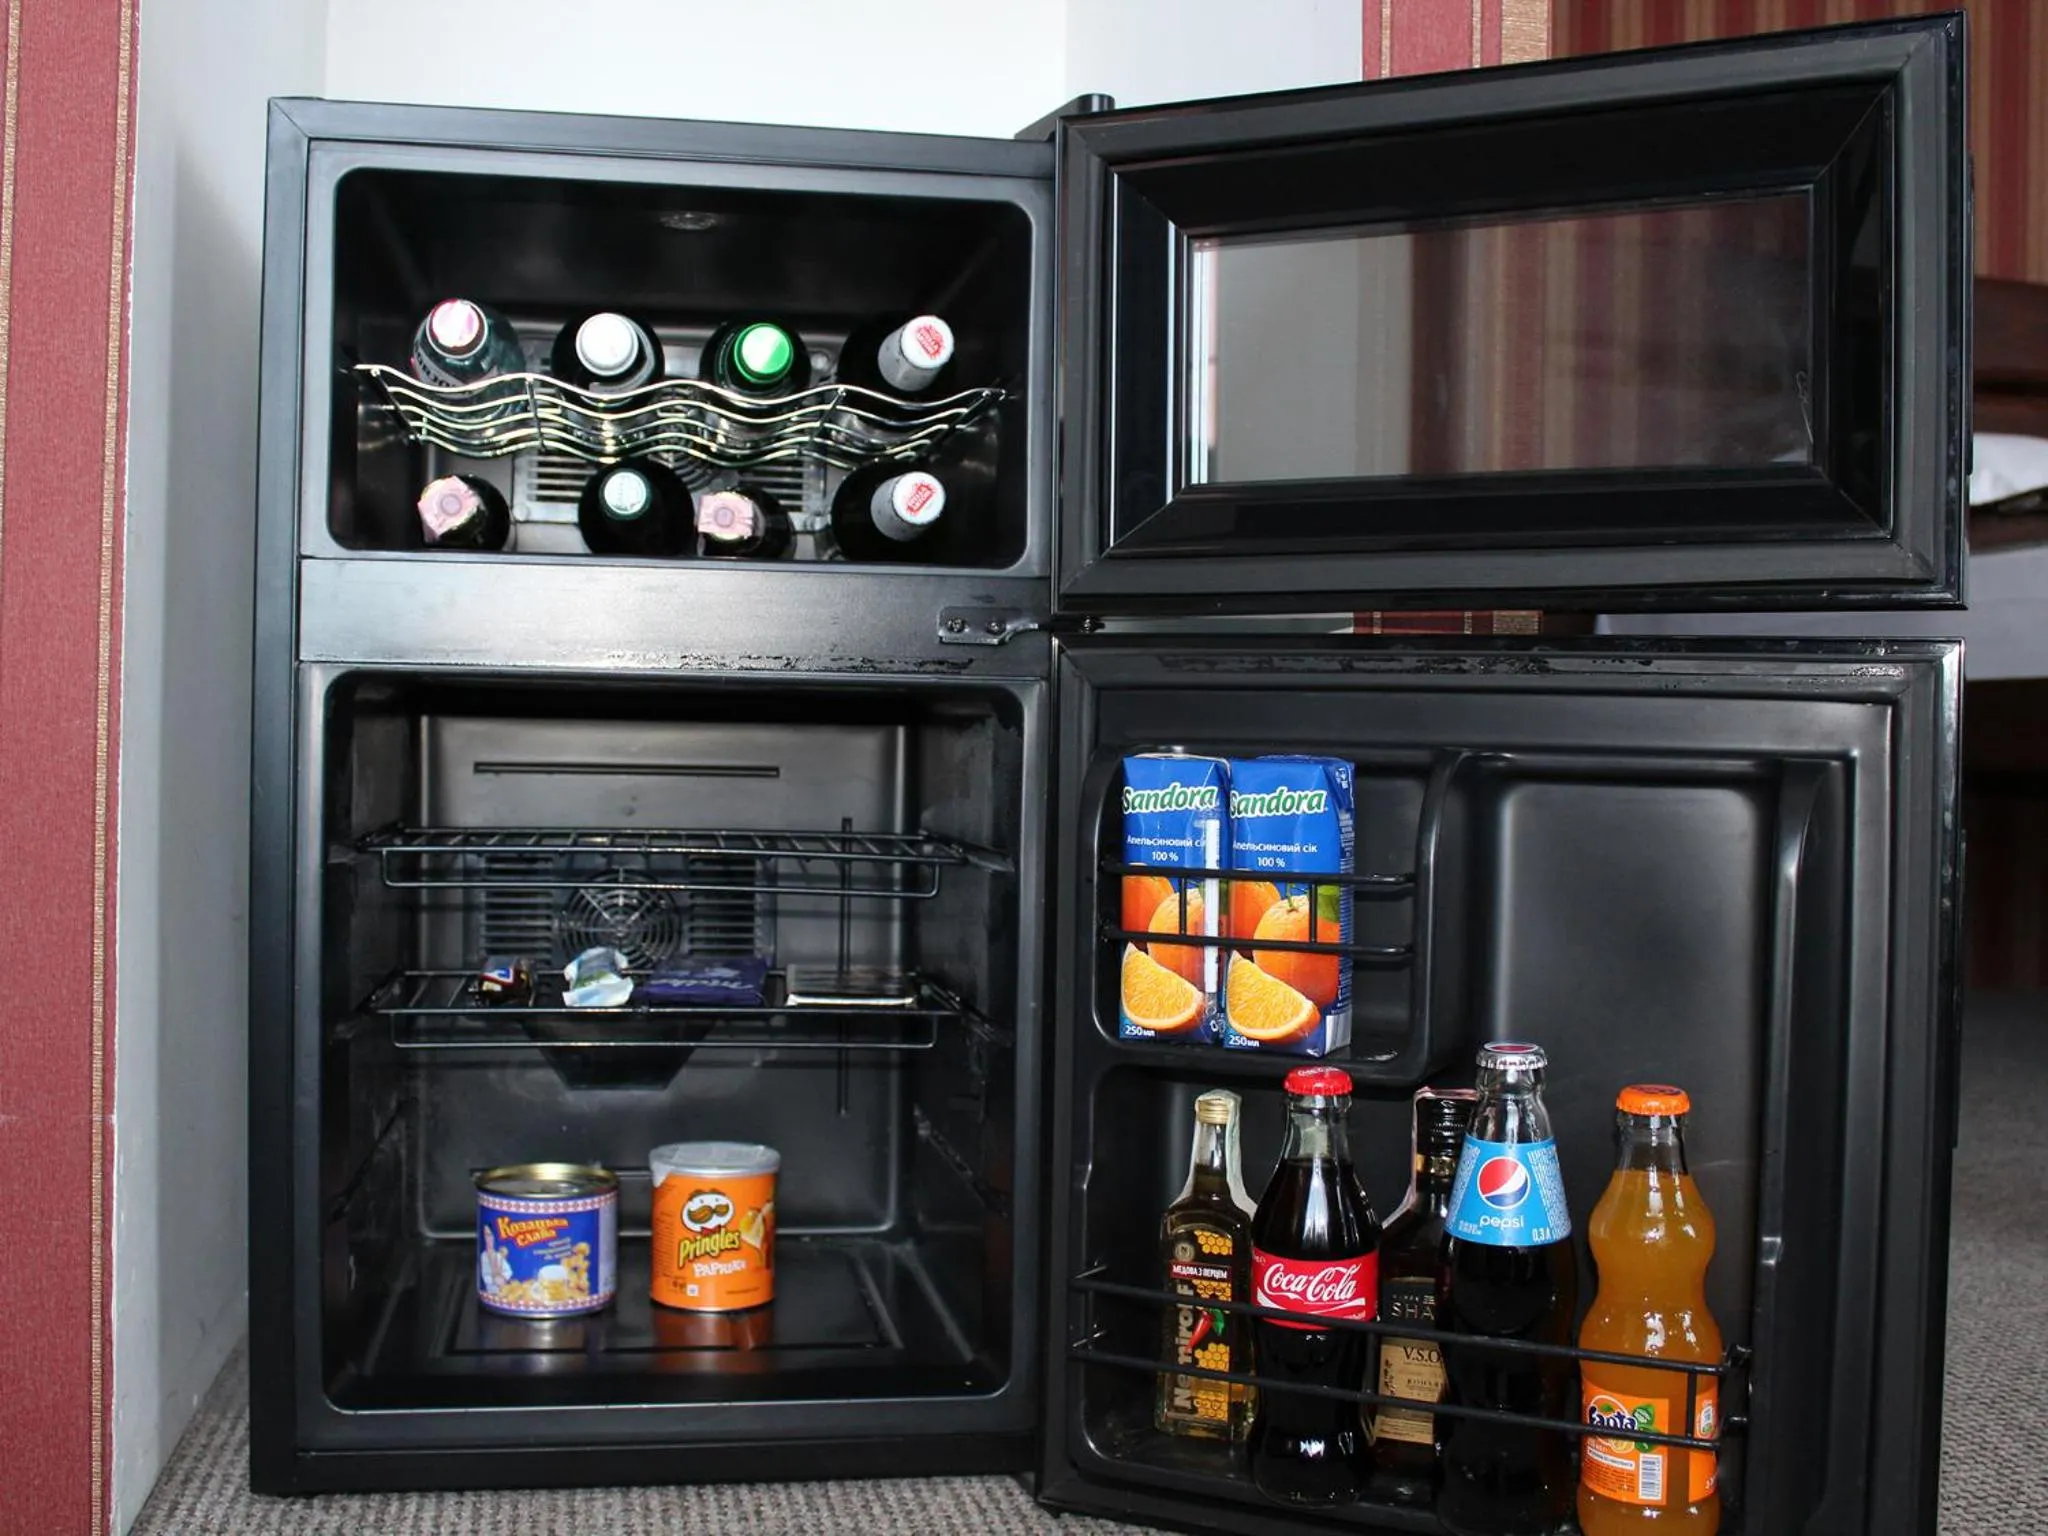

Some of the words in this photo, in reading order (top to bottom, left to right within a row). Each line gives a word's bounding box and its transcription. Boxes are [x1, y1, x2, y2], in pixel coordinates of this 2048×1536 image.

[1123, 782, 1217, 814] Sandora
[1230, 787, 1327, 819] Sandora
[1152, 851, 1168, 861] 100
[1169, 852, 1179, 862] %
[1302, 844, 1318, 853] сік
[1257, 857, 1275, 867] 100
[1275, 858, 1286, 868] %
[1480, 1215, 1524, 1230] pepsi
[678, 1228, 740, 1269] Pringles
[1264, 1263, 1362, 1304] Coca-Cola
[1391, 1301, 1436, 1321] SHA
[1402, 1345, 1441, 1364] V.S.O
